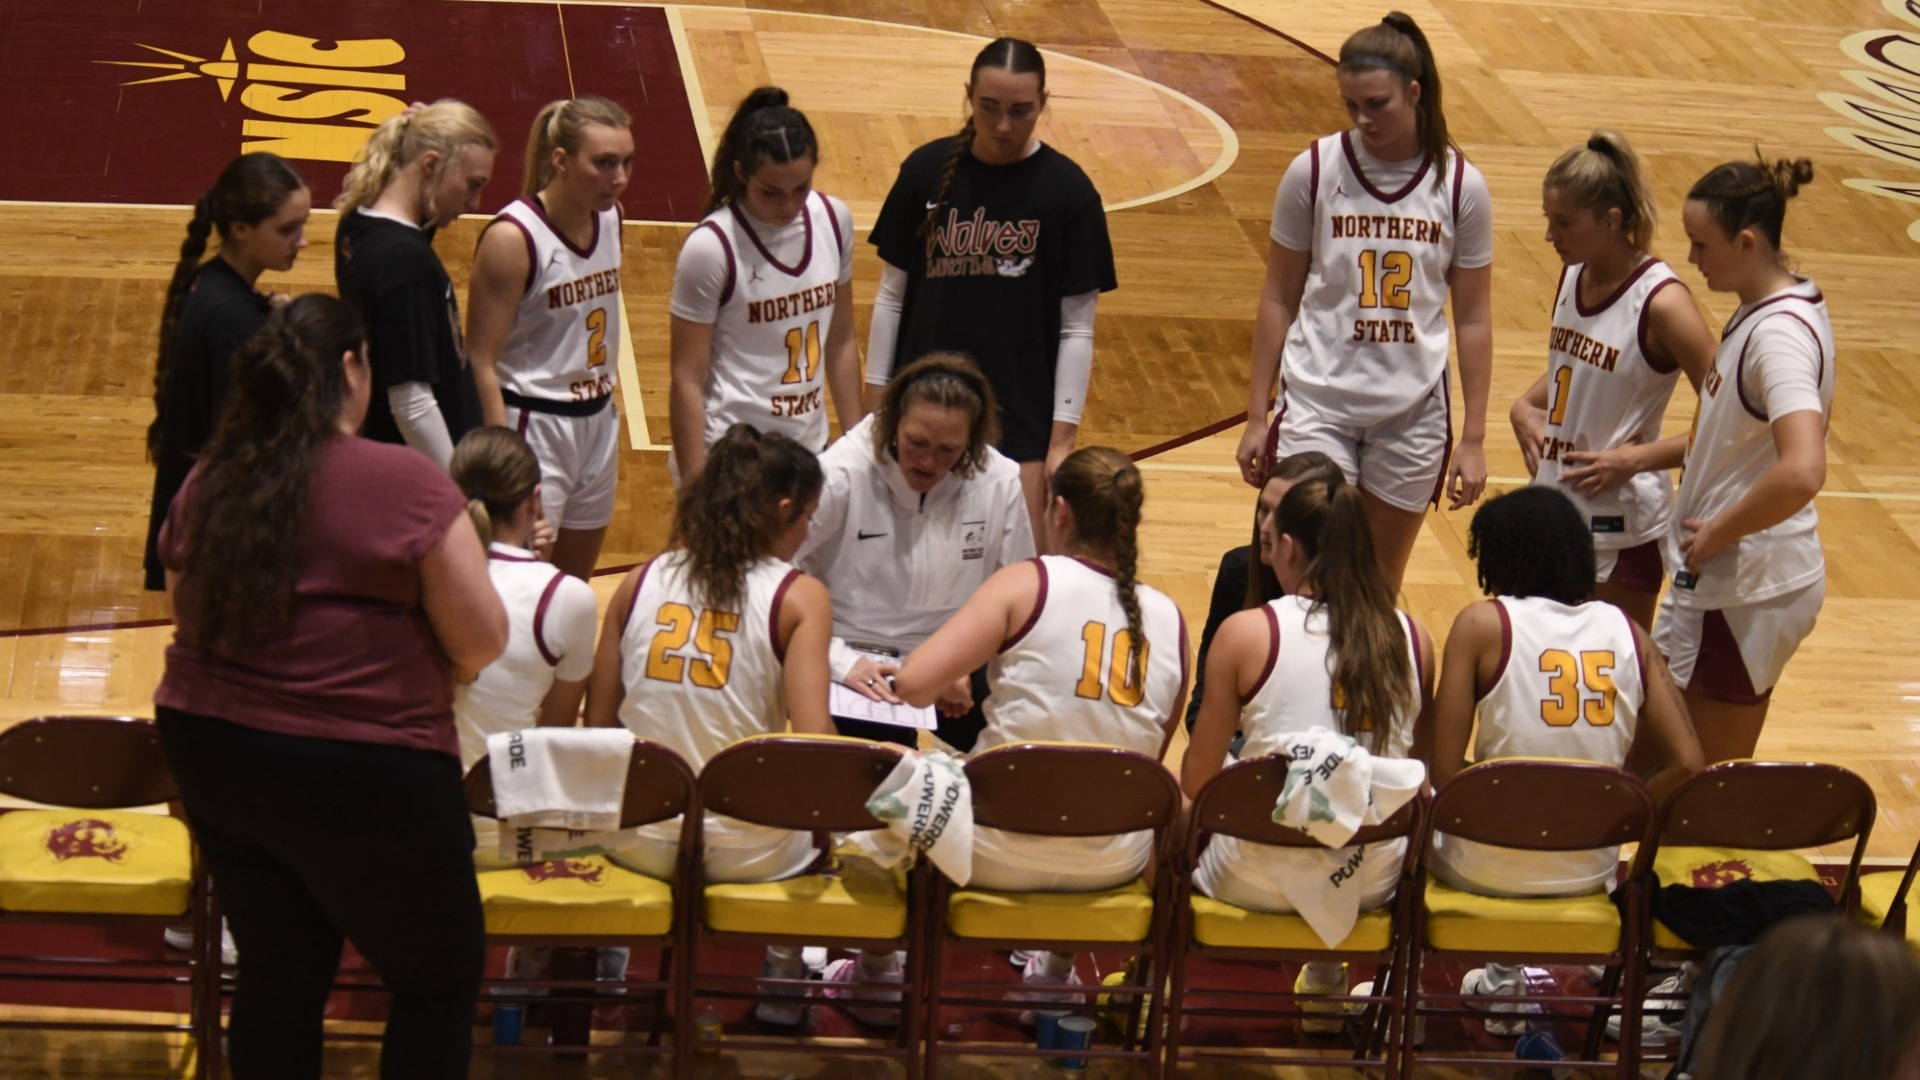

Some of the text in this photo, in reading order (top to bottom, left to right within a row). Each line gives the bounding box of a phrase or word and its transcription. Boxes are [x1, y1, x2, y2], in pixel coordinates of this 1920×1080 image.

[240, 30, 409, 163] NSIC
[926, 206, 1040, 258] Wolves
[1331, 215, 1442, 245] NORTHERN
[747, 280, 838, 323] NORTHER
[1358, 249, 1413, 311] 12
[586, 307, 607, 369] 2
[781, 320, 821, 385] 11
[1353, 319, 1416, 343] STATE
[1548, 364, 1573, 426] 1
[645, 601, 740, 690] 25
[1074, 619, 1150, 708] 10
[1538, 648, 1617, 728] 35
